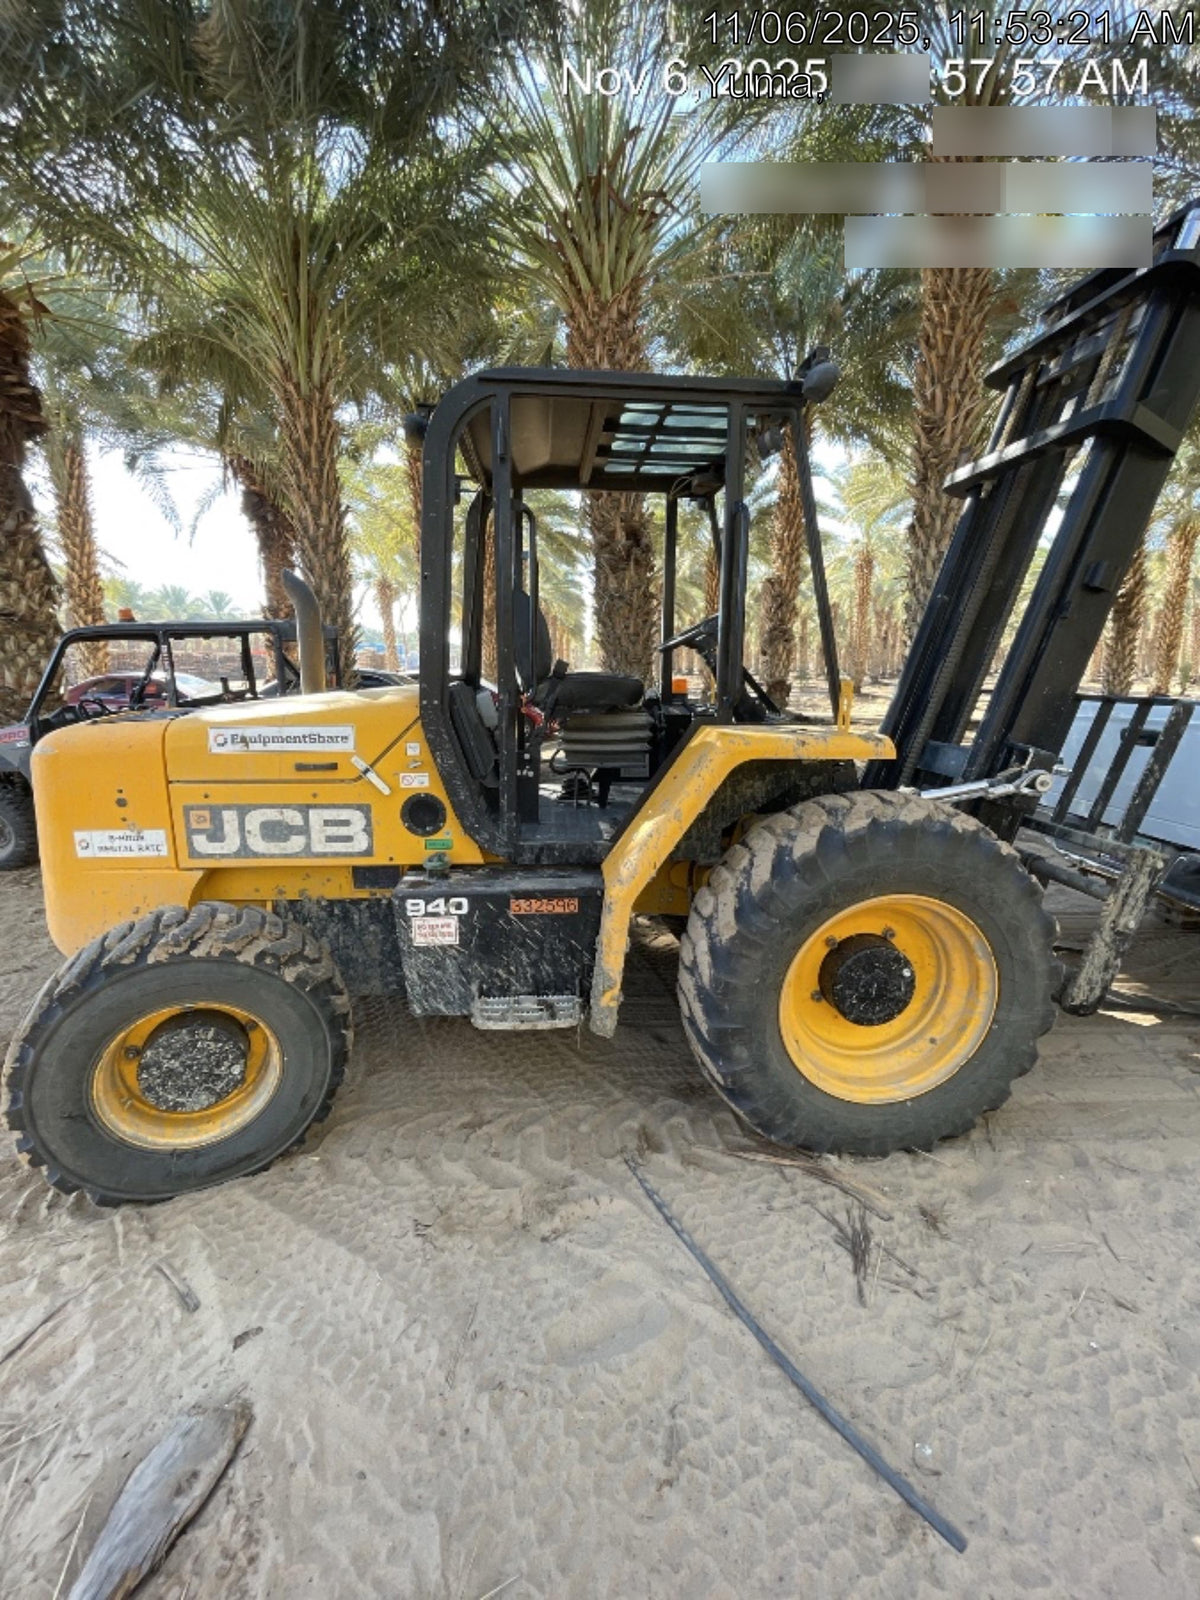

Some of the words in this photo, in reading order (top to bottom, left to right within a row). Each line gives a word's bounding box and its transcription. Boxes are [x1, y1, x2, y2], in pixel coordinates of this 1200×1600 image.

[192, 808, 369, 853] JCB
[405, 897, 468, 916] 940
[511, 899, 577, 912] 332596
